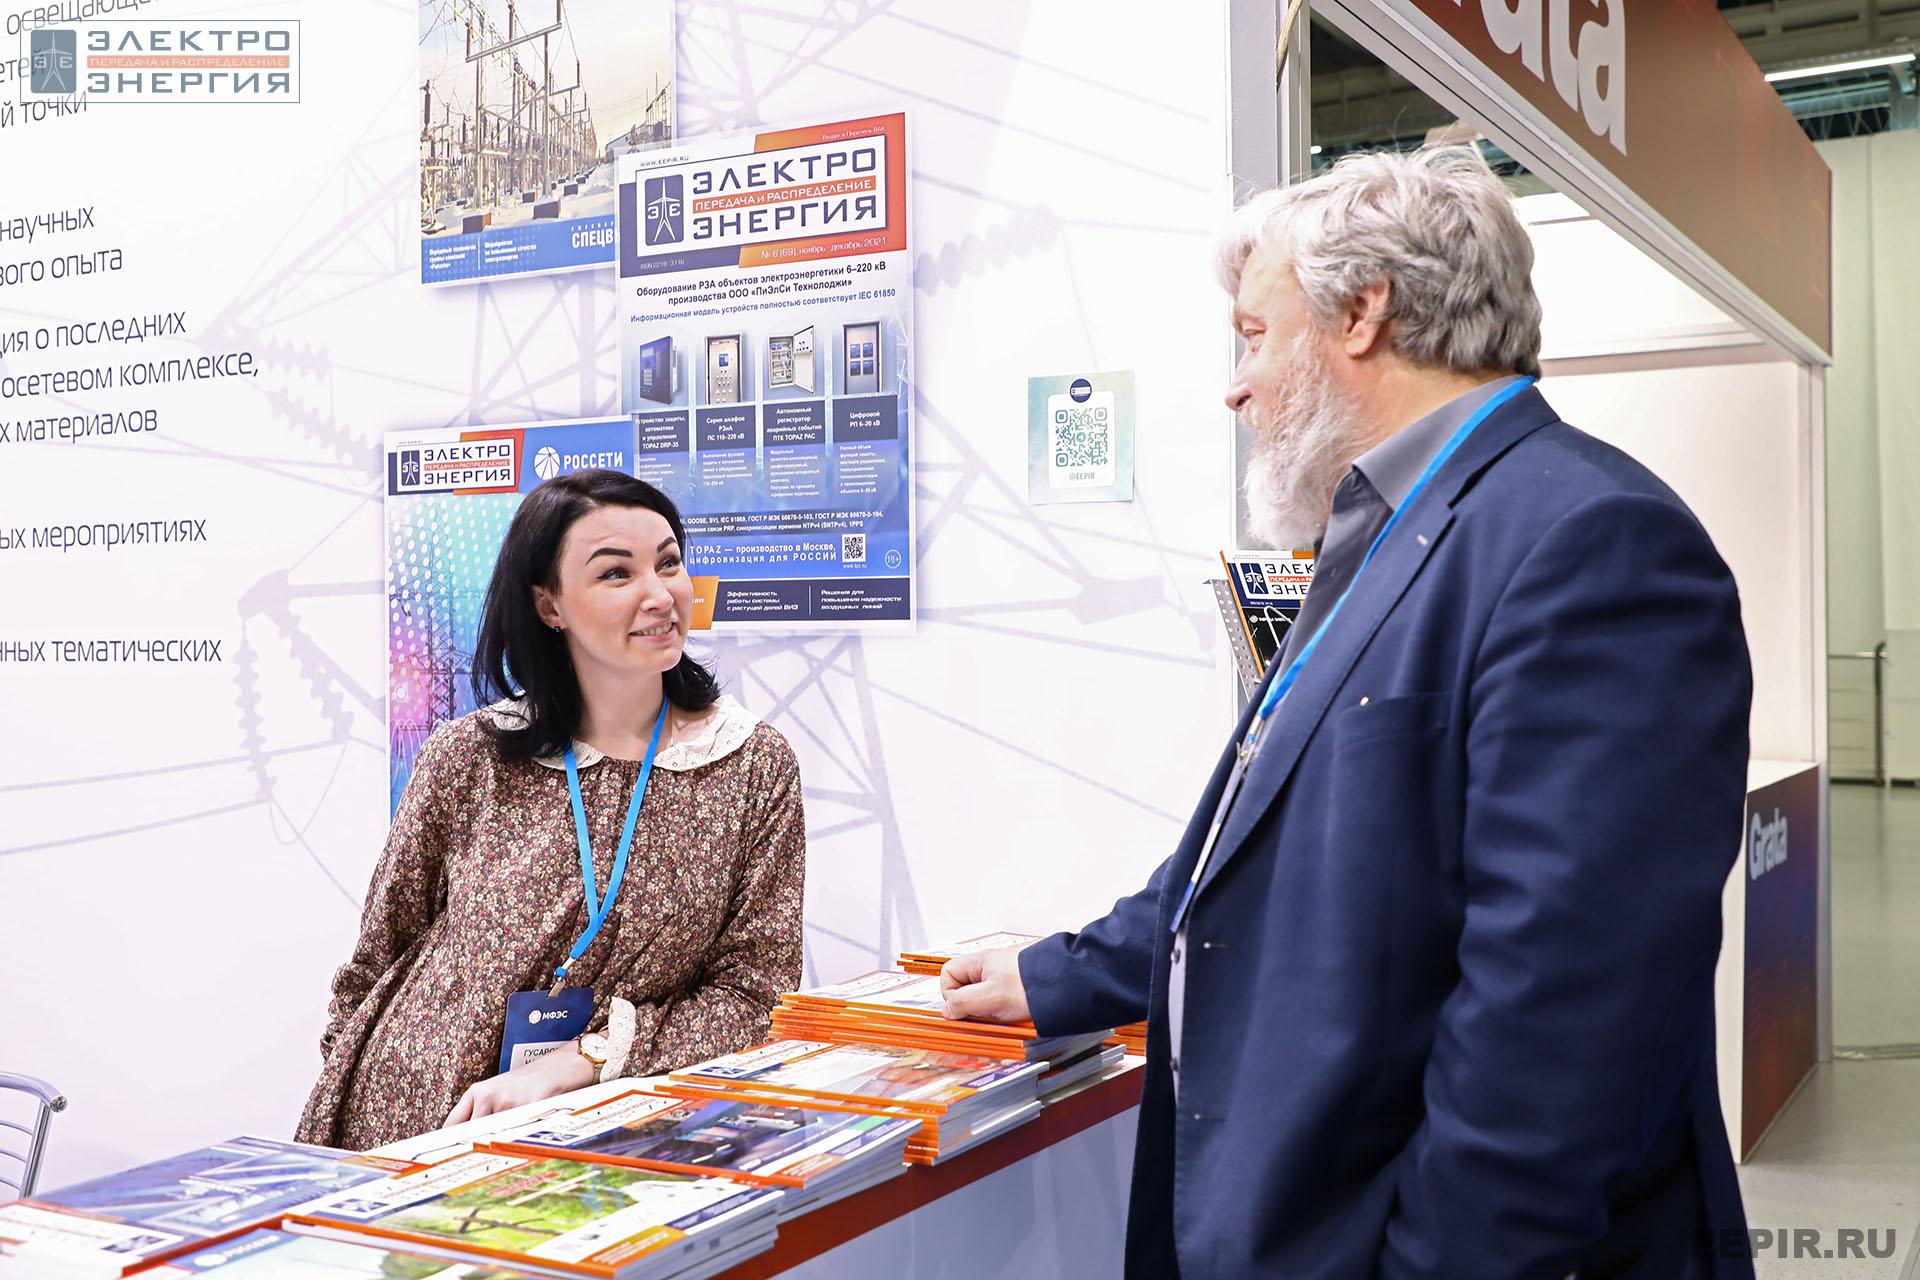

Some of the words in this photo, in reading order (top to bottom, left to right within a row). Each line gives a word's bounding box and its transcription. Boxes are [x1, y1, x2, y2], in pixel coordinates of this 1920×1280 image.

[20, 90, 87, 123] точки
[693, 147, 877, 195] ЭЛЕКТРО
[695, 196, 755, 212] ПЕРЕДАЧА
[767, 179, 872, 202] РАСПРЕДЕЛЕНИЕ
[693, 195, 877, 240] ЭНЕРГИЯ
[0, 206, 94, 244] научных
[864, 237, 886, 248] 2021
[51, 248, 122, 279] опыта
[637, 283, 697, 297] Оборудование
[718, 277, 759, 289] объектов
[760, 266, 844, 284] электроэнергетики
[875, 260, 886, 271] кВ
[669, 291, 727, 306] производства
[729, 288, 749, 299] ООО
[793, 279, 853, 293] Технолоджи»
[631, 310, 692, 323] Информационная
[693, 308, 720, 318] модель
[722, 303, 758, 316] устройств
[760, 299, 801, 311] полностью
[802, 293, 857, 306] соответствует
[873, 288, 896, 299] 61850
[35, 328, 49, 349] о
[56, 311, 186, 348] последних
[1, 367, 113, 399] осетевом
[120, 351, 259, 387] комплексе,
[776, 406, 812, 415] Автономный
[849, 411, 880, 420] Цифровой
[724, 415, 745, 424] шкафов
[777, 416, 811, 425] регистратор
[850, 420, 858, 428] РП
[873, 419, 881, 427] кВ
[17, 409, 158, 444] материалов
[766, 425, 797, 434] аварийных
[797, 424, 823, 432] событий
[773, 434, 784, 442] ПТК
[785, 433, 804, 441] TOPAZ
[642, 442, 660, 450] TOPAZ
[660, 441, 679, 449] DRP-35
[424, 444, 510, 462] ЭЛЕКТРО
[425, 462, 454, 471] ПЕРЕДАЧА
[459, 459, 510, 471] РАСПРЕДЕЛЕНИЕ
[564, 451, 623, 470] РОССЕТИ
[424, 469, 510, 485] ЭНЕРГИЯ
[1069, 472, 1095, 481] @EEPIR
[815, 512, 829, 520] ГОСТ
[836, 511, 849, 519] МЭК
[802, 522, 820, 530] NTPv4
[849, 520, 864, 529] 1PPS
[32, 519, 206, 553] мероприятиях
[689, 545, 722, 556] TOPAZ
[736, 545, 794, 556] производство
[802, 542, 836, 553] Москве,
[689, 555, 765, 567] цифровизация
[769, 555, 788, 563] для
[793, 550, 837, 562] РОССИИ
[727, 591, 778, 599] Эффективность
[821, 589, 851, 597] Решения
[851, 589, 864, 597] для
[727, 598, 751, 606] работы
[752, 597, 780, 605] системы
[821, 596, 860, 604] повышения
[861, 596, 902, 604] надежности
[732, 604, 763, 613] растущей
[763, 604, 783, 612] долей
[821, 603, 859, 612] воздушных
[862, 602, 883, 610] линий
[51, 639, 222, 662] тематических
[1749, 807, 1788, 881] Grata
[541, 1010, 568, 1021] МФЭС
[524, 1047, 560, 1057] ГУСАР
